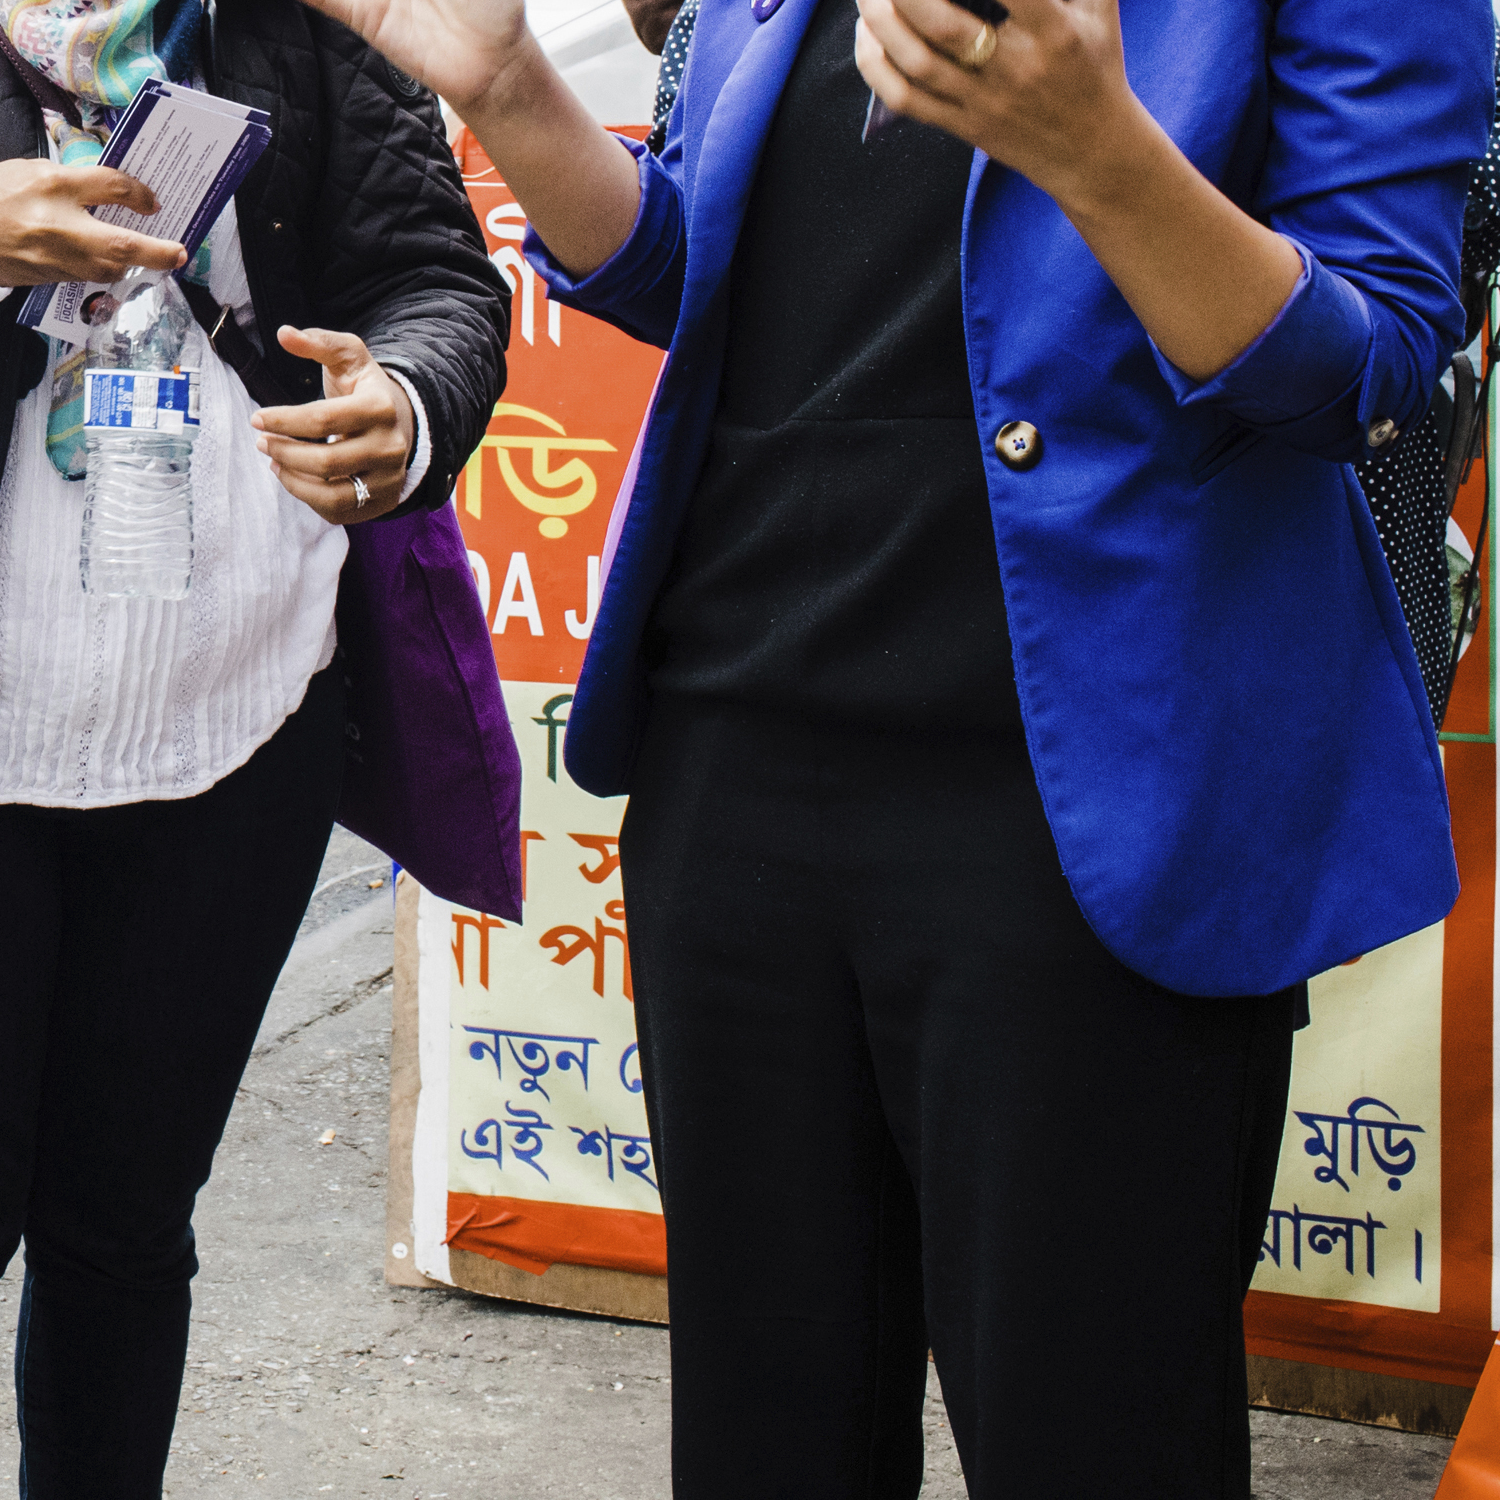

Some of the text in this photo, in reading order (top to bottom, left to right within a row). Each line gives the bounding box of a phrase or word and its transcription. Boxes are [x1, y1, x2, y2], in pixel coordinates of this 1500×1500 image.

[62, 282, 78, 320] ¡OCASIO
[461, 1025, 600, 1104] নতুন
[461, 1100, 660, 1191] এই শহ
[1292, 1096, 1426, 1193] মুড়ি
